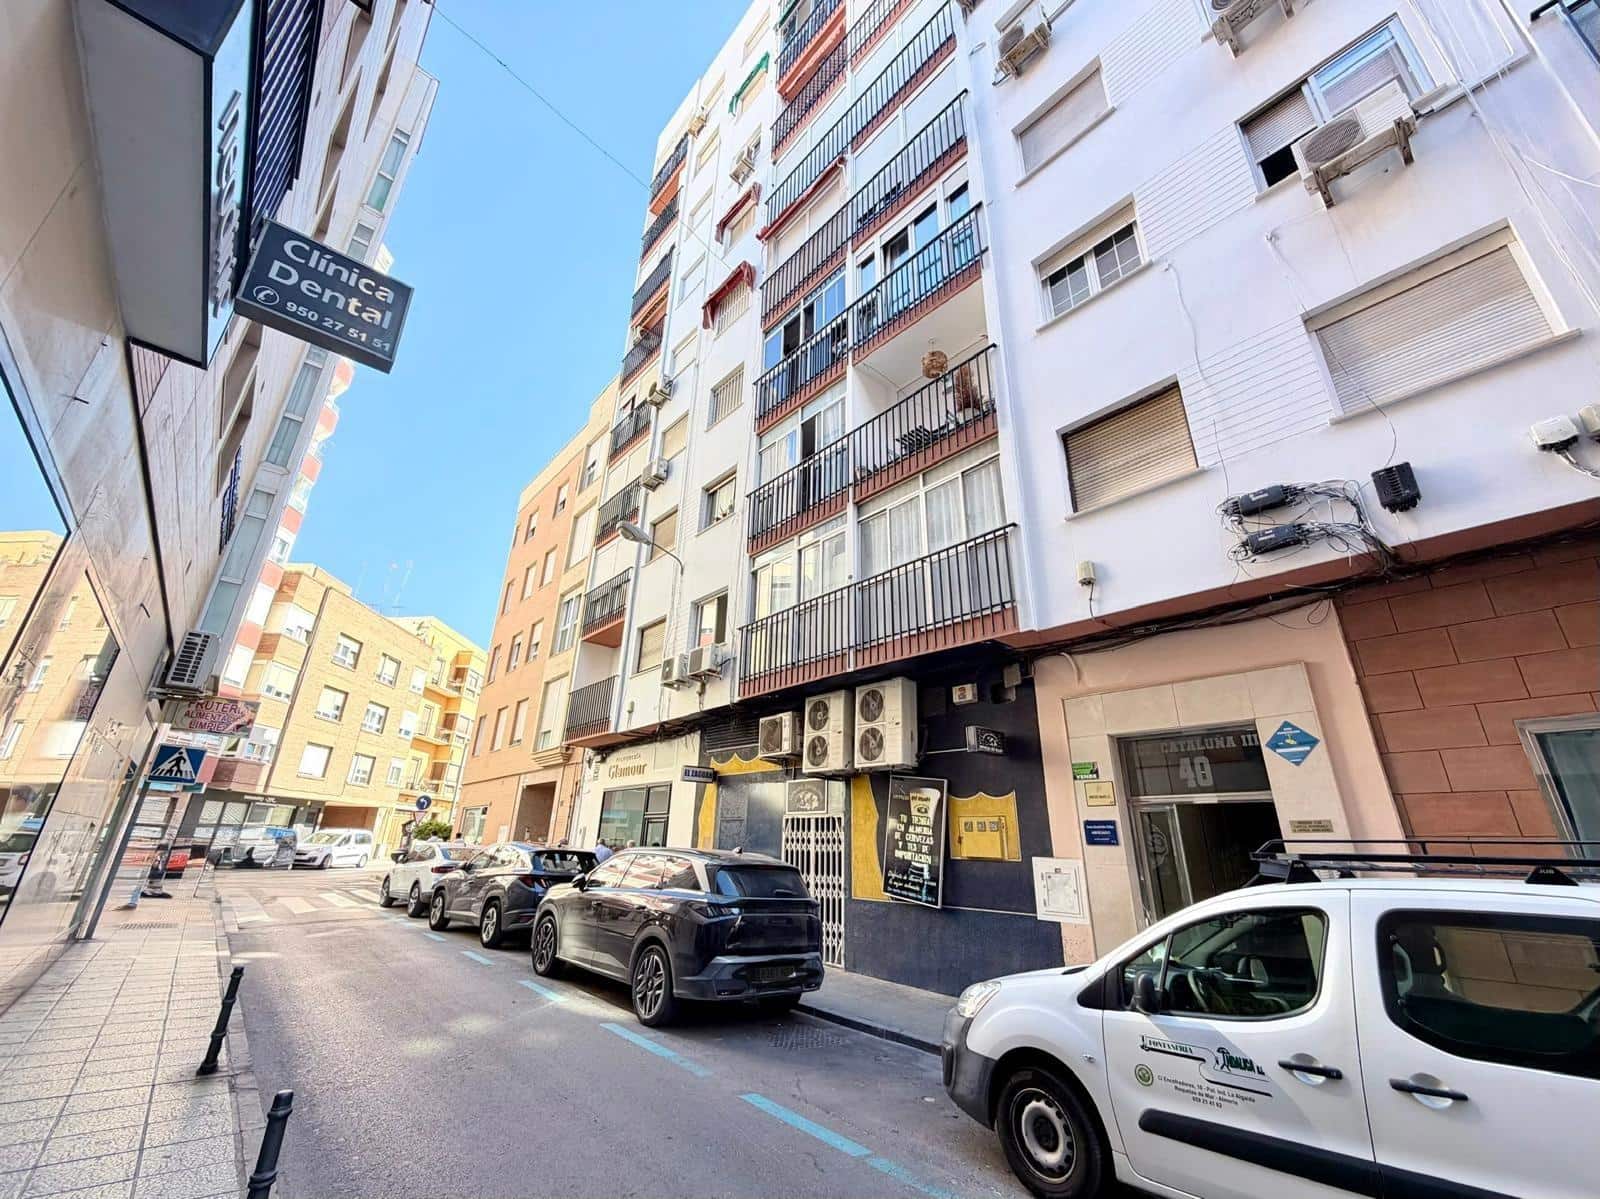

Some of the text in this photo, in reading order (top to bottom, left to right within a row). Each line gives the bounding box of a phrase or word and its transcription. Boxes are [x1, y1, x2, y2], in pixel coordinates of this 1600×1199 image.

[283, 239, 395, 304] Clínica
[268, 259, 393, 329] Dental
[286, 301, 391, 352] 950 27 51 51
[184, 709, 240, 724] ALIMENTAC
[187, 700, 243, 715] FRUTER
[188, 719, 240, 732] LIMPIEA
[1161, 733, 1260, 753] CATALUÑA III
[608, 763, 647, 780] Glamour
[1180, 755, 1215, 788] 40
[905, 833, 934, 845] CERVEZAS
